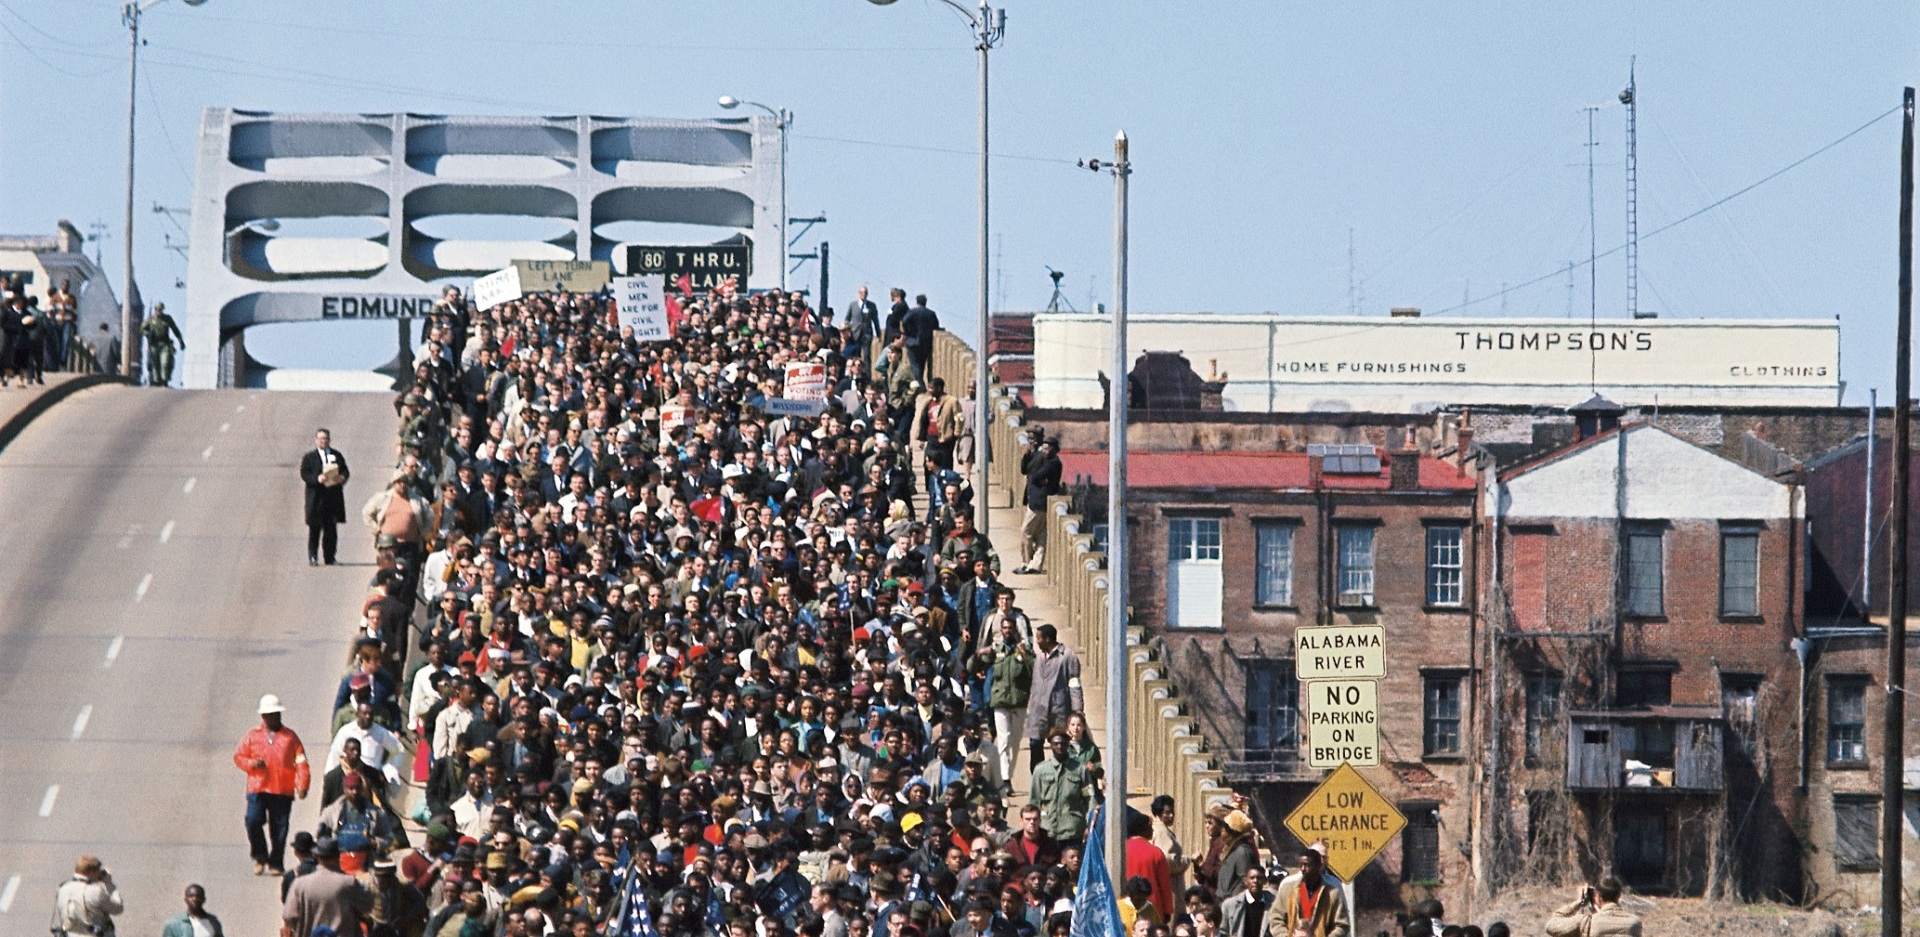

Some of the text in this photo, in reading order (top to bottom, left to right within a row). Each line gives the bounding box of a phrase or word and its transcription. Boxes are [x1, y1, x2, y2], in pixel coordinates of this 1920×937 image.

[528, 261, 593, 271] LEFT TURN
[644, 252, 740, 268] 80 THRU.
[543, 273, 572, 281] LANE
[627, 281, 649, 289] CIVIL
[628, 292, 648, 301] MEN
[322, 296, 434, 319] EDMUND
[622, 303, 659, 313] ARE FOR
[632, 317, 653, 325] CIVIL
[1455, 330, 1652, 351] THOMPSON'S
[1277, 361, 1467, 373] HOME FURNISHINGS
[1729, 365, 1828, 377] CLOTHING
[790, 387, 822, 396] VOTING
[1299, 634, 1381, 650] ALABAMA
[1315, 655, 1365, 670] RIVER
[1326, 686, 1360, 706] NO
[1311, 710, 1375, 725] PARKING
[1332, 729, 1355, 743] ON
[1314, 746, 1373, 761] BRIDGE
[1326, 791, 1364, 809] LOW
[1301, 814, 1389, 831] CLEARANCE
[1332, 840, 1347, 851] FT.
[1352, 836, 1358, 852] 1
[1361, 840, 1376, 851] IN.
